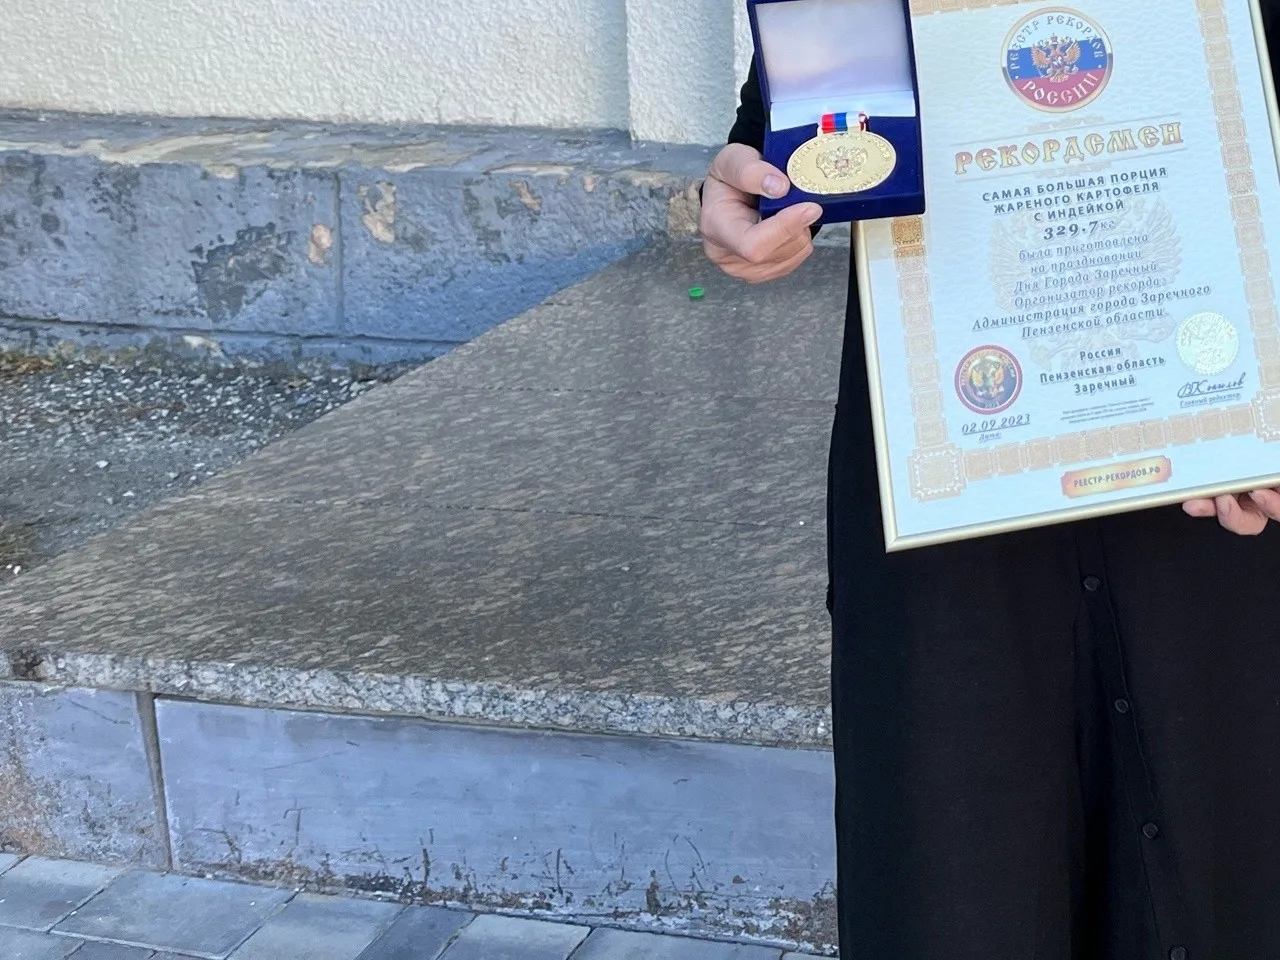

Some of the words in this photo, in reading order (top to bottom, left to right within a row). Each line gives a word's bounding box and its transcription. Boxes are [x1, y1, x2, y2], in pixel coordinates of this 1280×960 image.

[1022, 72, 1099, 105] РОССИИ
[954, 121, 1184, 175] РЕКОРДСМЕН
[982, 186, 1031, 203] САМАЯ
[1037, 175, 1105, 194] БОЛЬШАЯ
[1110, 166, 1167, 184] ПОРЦИЯ
[994, 194, 1070, 215] ЖАРЕНОГО
[1077, 181, 1160, 201] КАРТОФЕЛЯ
[1034, 211, 1041, 222] С
[1048, 199, 1125, 220] ИНДЕЙКОЙ
[1019, 247, 1052, 263] была
[1056, 232, 1149, 258] приготовлена
[1030, 264, 1045, 275] на
[1051, 250, 1142, 275] праздновании
[1014, 280, 1039, 295] Дня
[1044, 272, 1089, 290] Города
[972, 301, 1085, 332] Администрация
[1090, 293, 1137, 313] города
[1140, 285, 1211, 306] Заречного
[1014, 286, 1104, 309] Организатор
[1022, 315, 1101, 340] Пензенской
[1080, 346, 1121, 362] Россия
[1040, 365, 1113, 385] Пензенская
[1117, 355, 1166, 373] область
[1074, 375, 1136, 395] Заречный
[961, 413, 1031, 435] 02.09.2023
[1073, 465, 1161, 488] РЕЕСТР-РЕКОРДОВ.РФ
